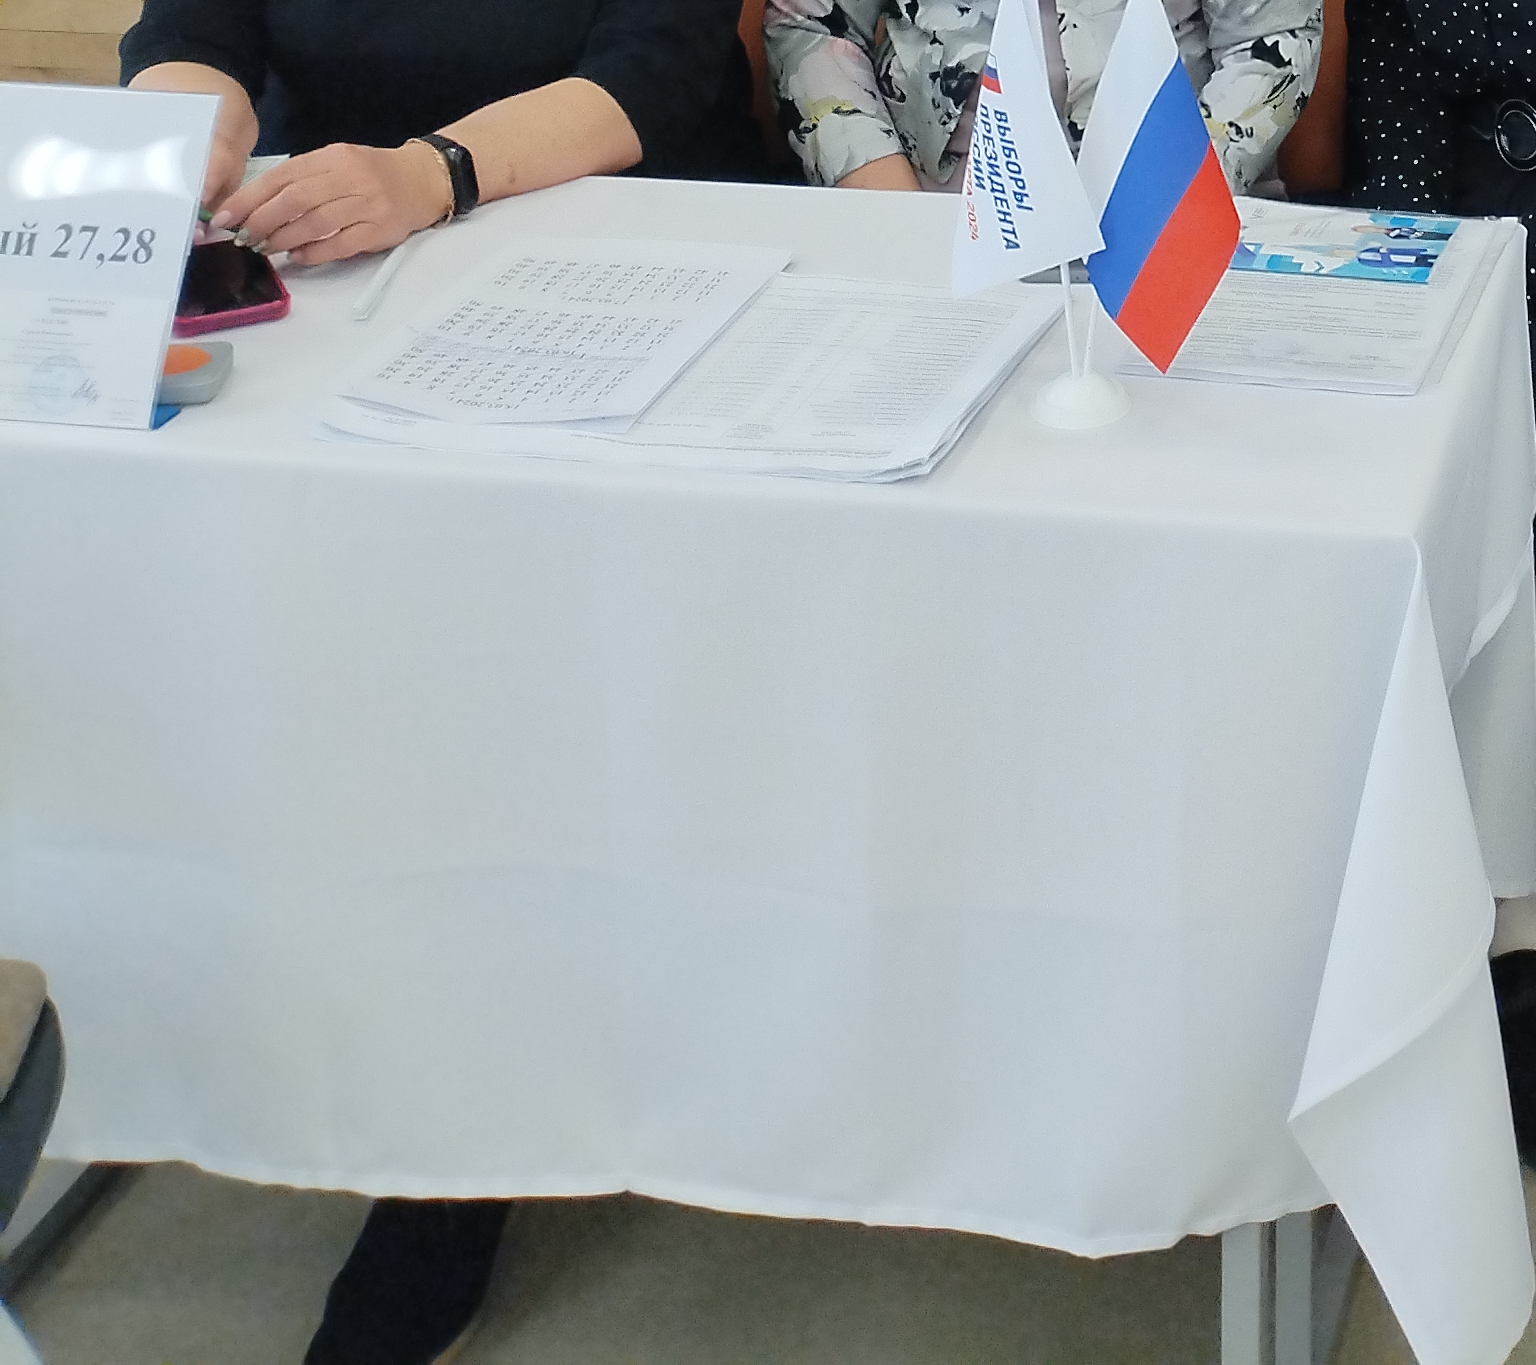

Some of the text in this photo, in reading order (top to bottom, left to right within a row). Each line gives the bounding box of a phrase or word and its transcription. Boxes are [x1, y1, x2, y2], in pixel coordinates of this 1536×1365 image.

[980, 103, 1021, 250] ПРЕЗИДЕНТА
[993, 108, 1034, 212] ВЫБОРЫ
[50, 223, 156, 269] 27,28
